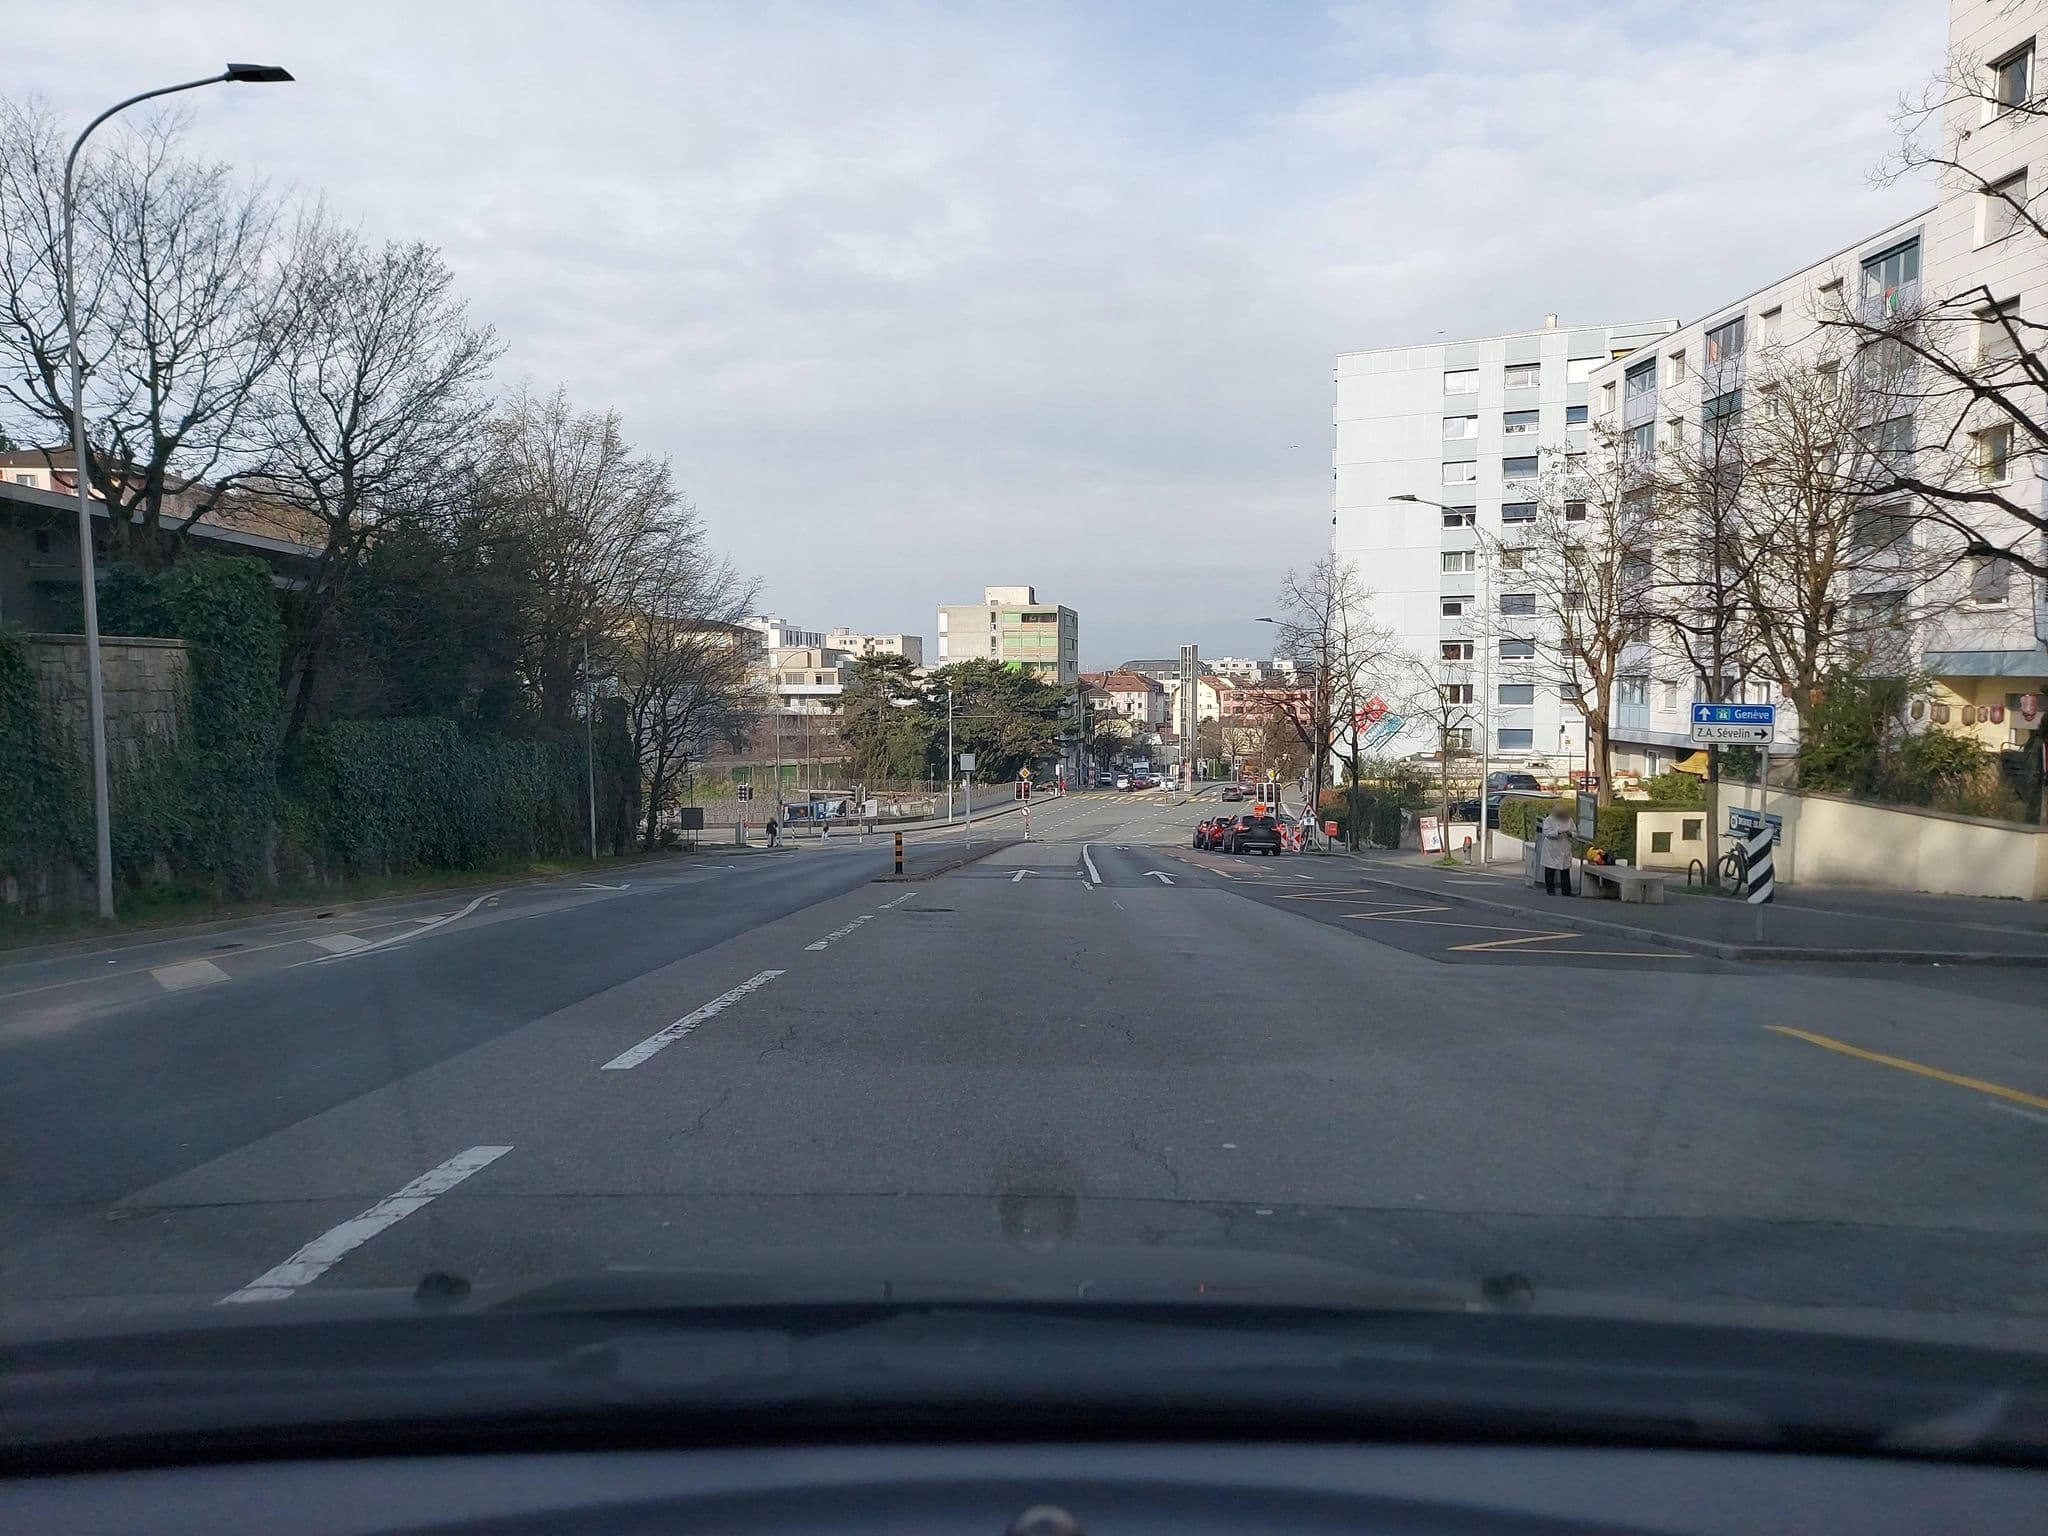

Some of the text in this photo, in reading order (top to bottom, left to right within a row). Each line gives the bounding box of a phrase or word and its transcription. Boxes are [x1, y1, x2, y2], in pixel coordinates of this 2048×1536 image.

[1734, 708, 1770, 720] Genève
[1697, 727, 1750, 738] Z.A. Sévelin
